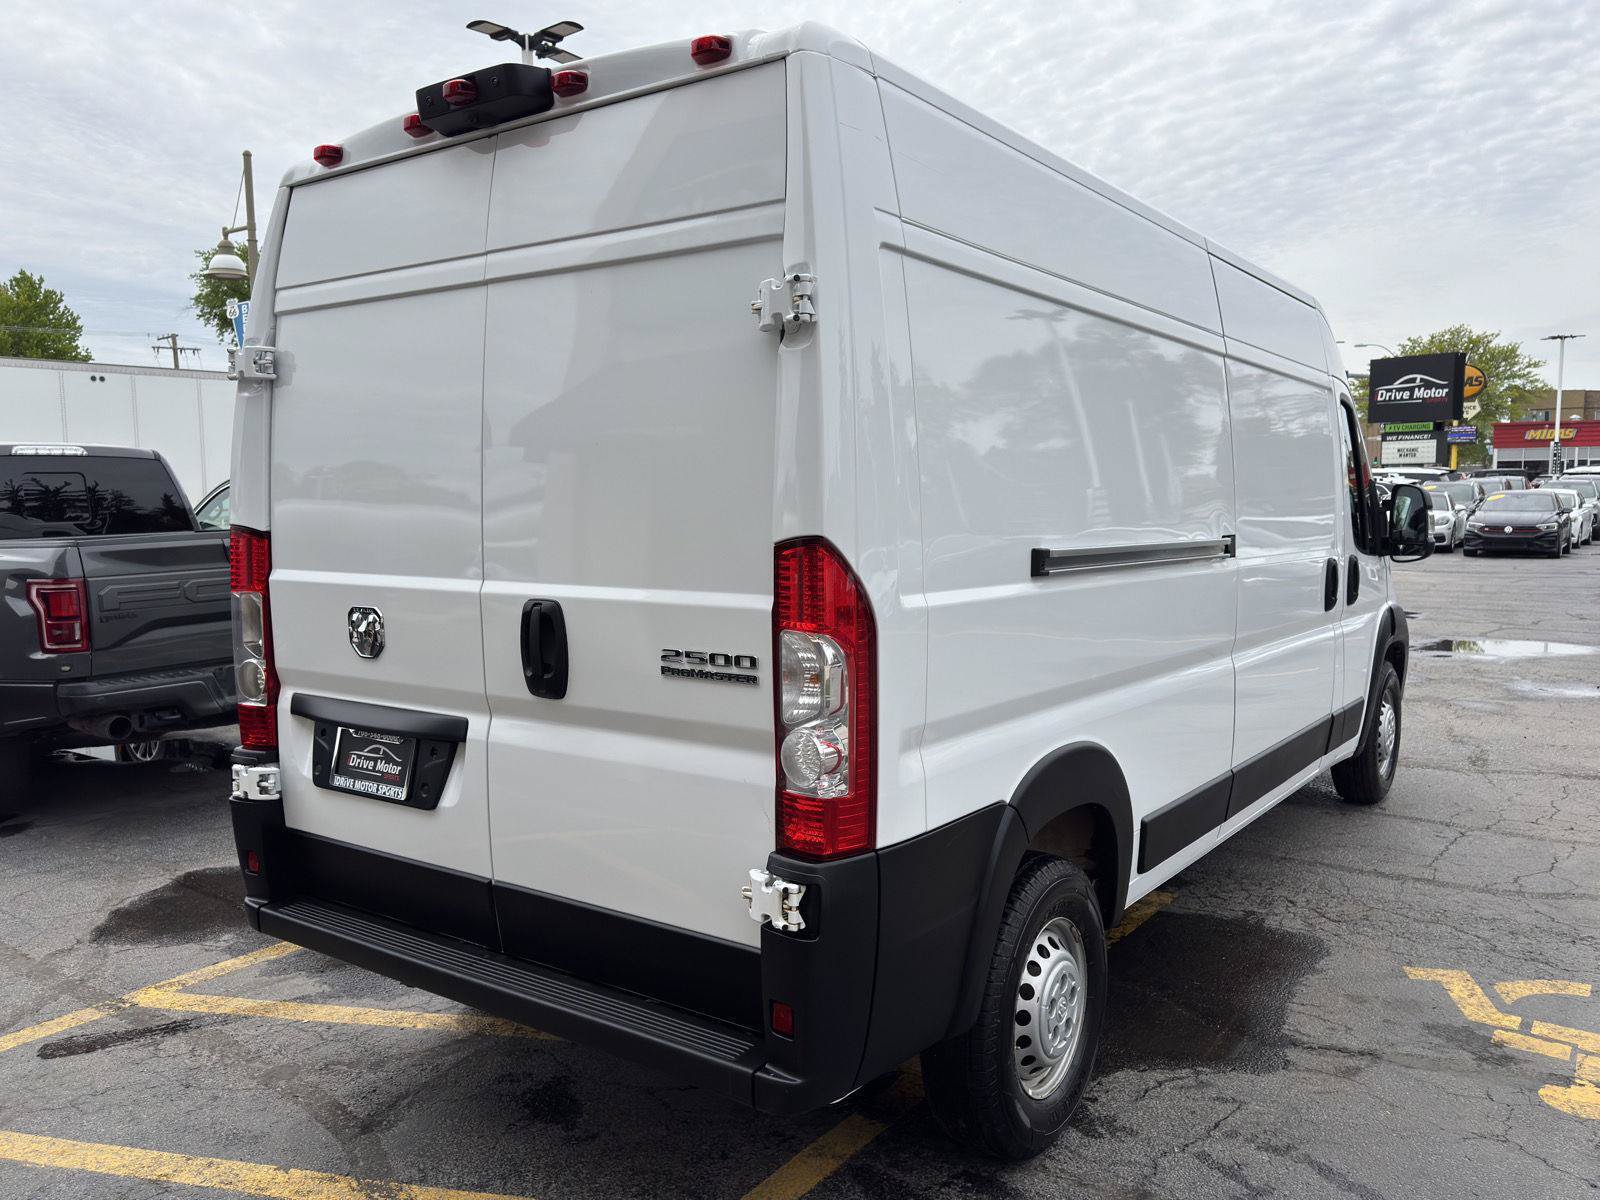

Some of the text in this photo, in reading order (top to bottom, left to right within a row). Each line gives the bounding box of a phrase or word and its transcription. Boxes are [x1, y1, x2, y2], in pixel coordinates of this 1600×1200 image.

[1377, 389, 1410, 401] Drive
[1413, 386, 1449, 399] Motor
[660, 648, 759, 669] 2500
[349, 755, 402, 775] Drive Motor
[354, 780, 378, 793] MOTOR
[378, 785, 404, 799] SPORTS
